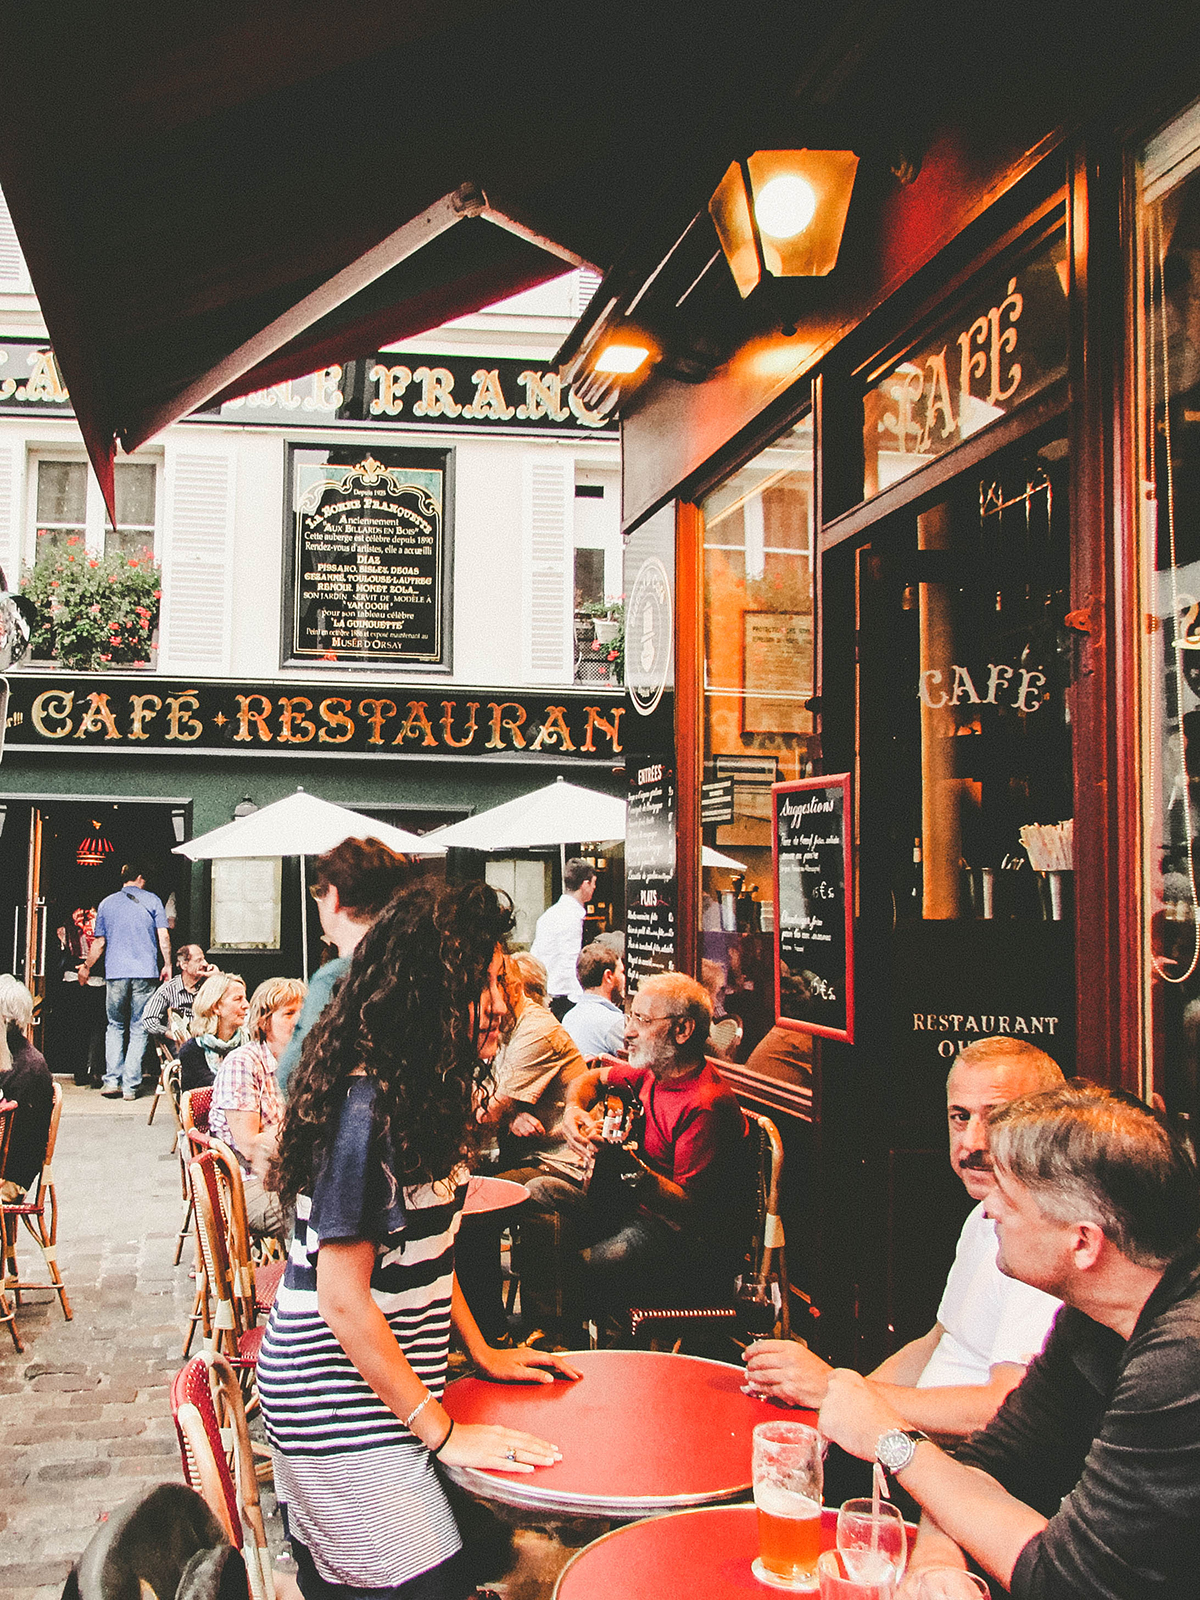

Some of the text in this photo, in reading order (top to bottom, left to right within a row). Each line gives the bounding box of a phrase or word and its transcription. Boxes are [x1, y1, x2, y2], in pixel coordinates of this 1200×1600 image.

[897, 277, 1023, 453] CAFÉ
[304, 514, 325, 529] LA
[321, 499, 361, 518] BONNE
[339, 515, 399, 526] Anciennement
[304, 532, 323, 541] Cette
[324, 533, 353, 543] auberge
[392, 535, 416, 546] depuis
[417, 536, 434, 545] 1890
[345, 525, 383, 534] BILLARDS
[305, 542, 350, 552] Rendez-vous
[384, 546, 397, 554] elle
[320, 592, 347, 600] JARDIN
[321, 610, 341, 618] pour
[917, 663, 1047, 712] CAFÉ
[31, 689, 204, 742] CAFÉ
[233, 692, 626, 753] RESTAURAN
[637, 764, 663, 785] ENTRÉES
[780, 796, 834, 829] Suggestions
[640, 889, 657, 907] PLATS
[913, 1013, 1059, 1035] RESTAURANT
